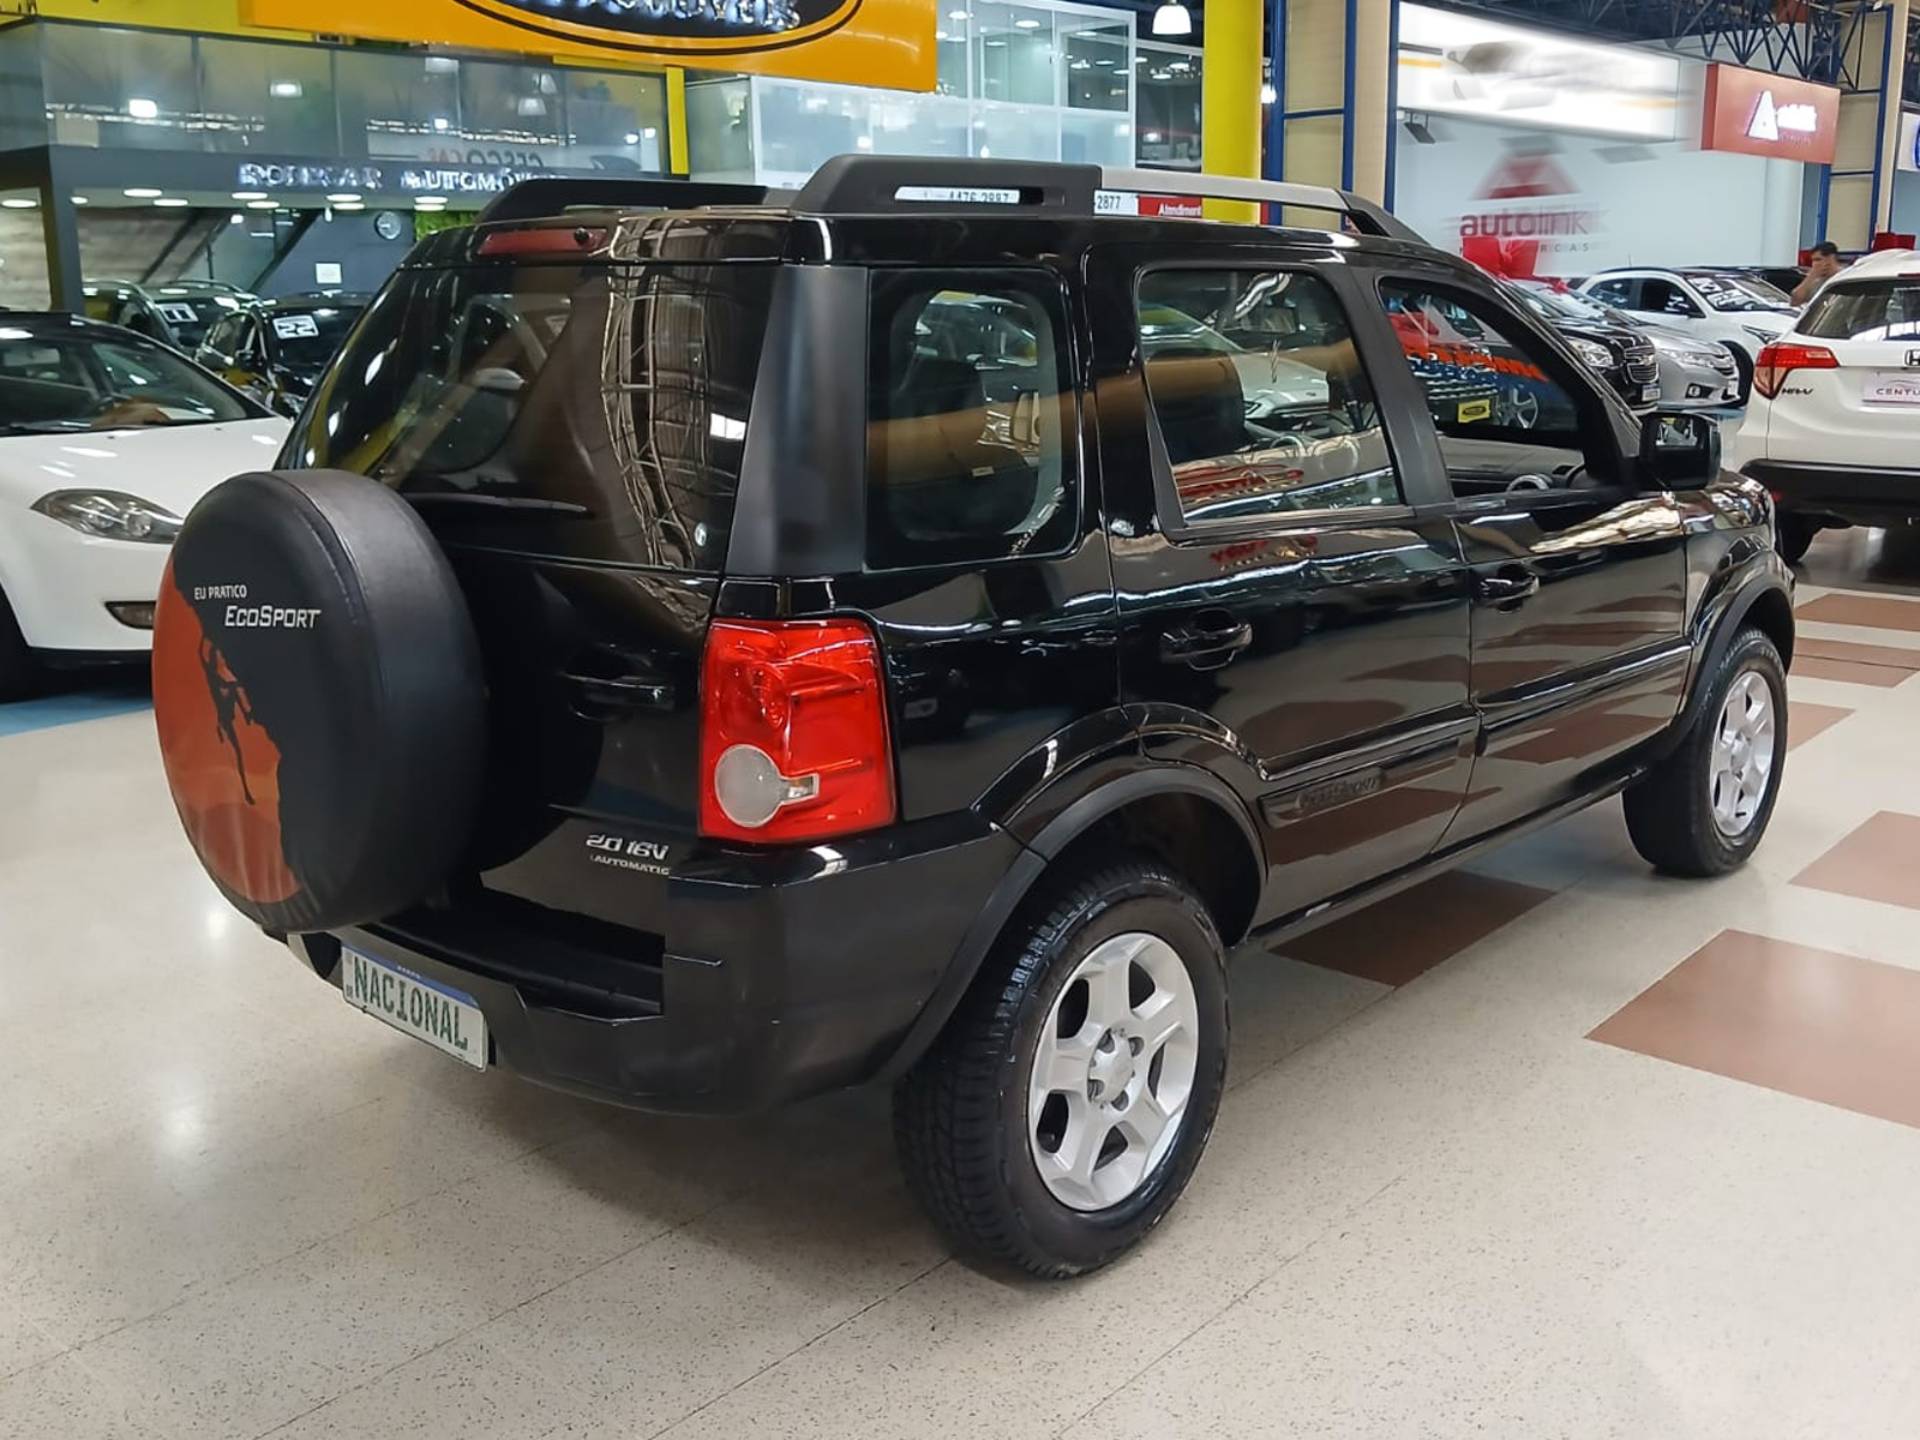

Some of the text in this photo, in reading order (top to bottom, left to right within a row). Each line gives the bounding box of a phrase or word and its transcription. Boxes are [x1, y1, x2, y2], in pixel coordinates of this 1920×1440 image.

[1096, 195, 1121, 210] 2877
[1460, 208, 1591, 237] autolink
[193, 584, 248, 600] EU PRATICO
[224, 605, 322, 628] ECOSPORT
[626, 840, 669, 860] 16V
[592, 855, 671, 876] AUTOMATIC
[354, 956, 469, 1051] NACIONAL
